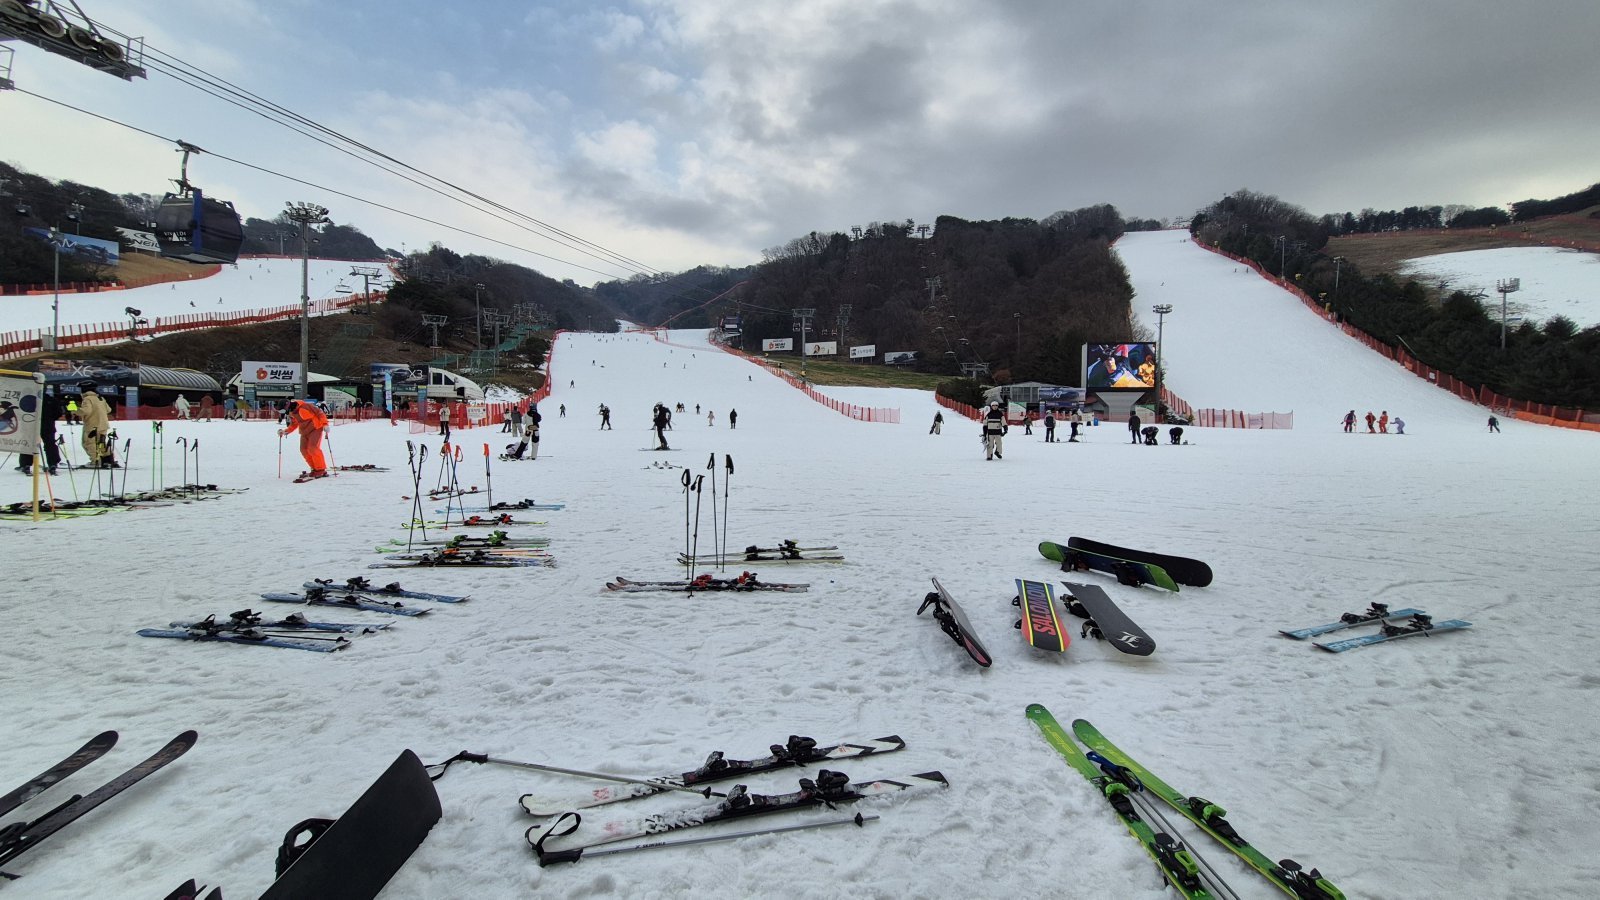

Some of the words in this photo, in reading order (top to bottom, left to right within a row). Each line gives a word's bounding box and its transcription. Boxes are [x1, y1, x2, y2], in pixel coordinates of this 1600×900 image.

[269, 369, 294, 380] 빗썸
[408, 369, 423, 379] X3
[1026, 583, 1057, 636] SALOMON
